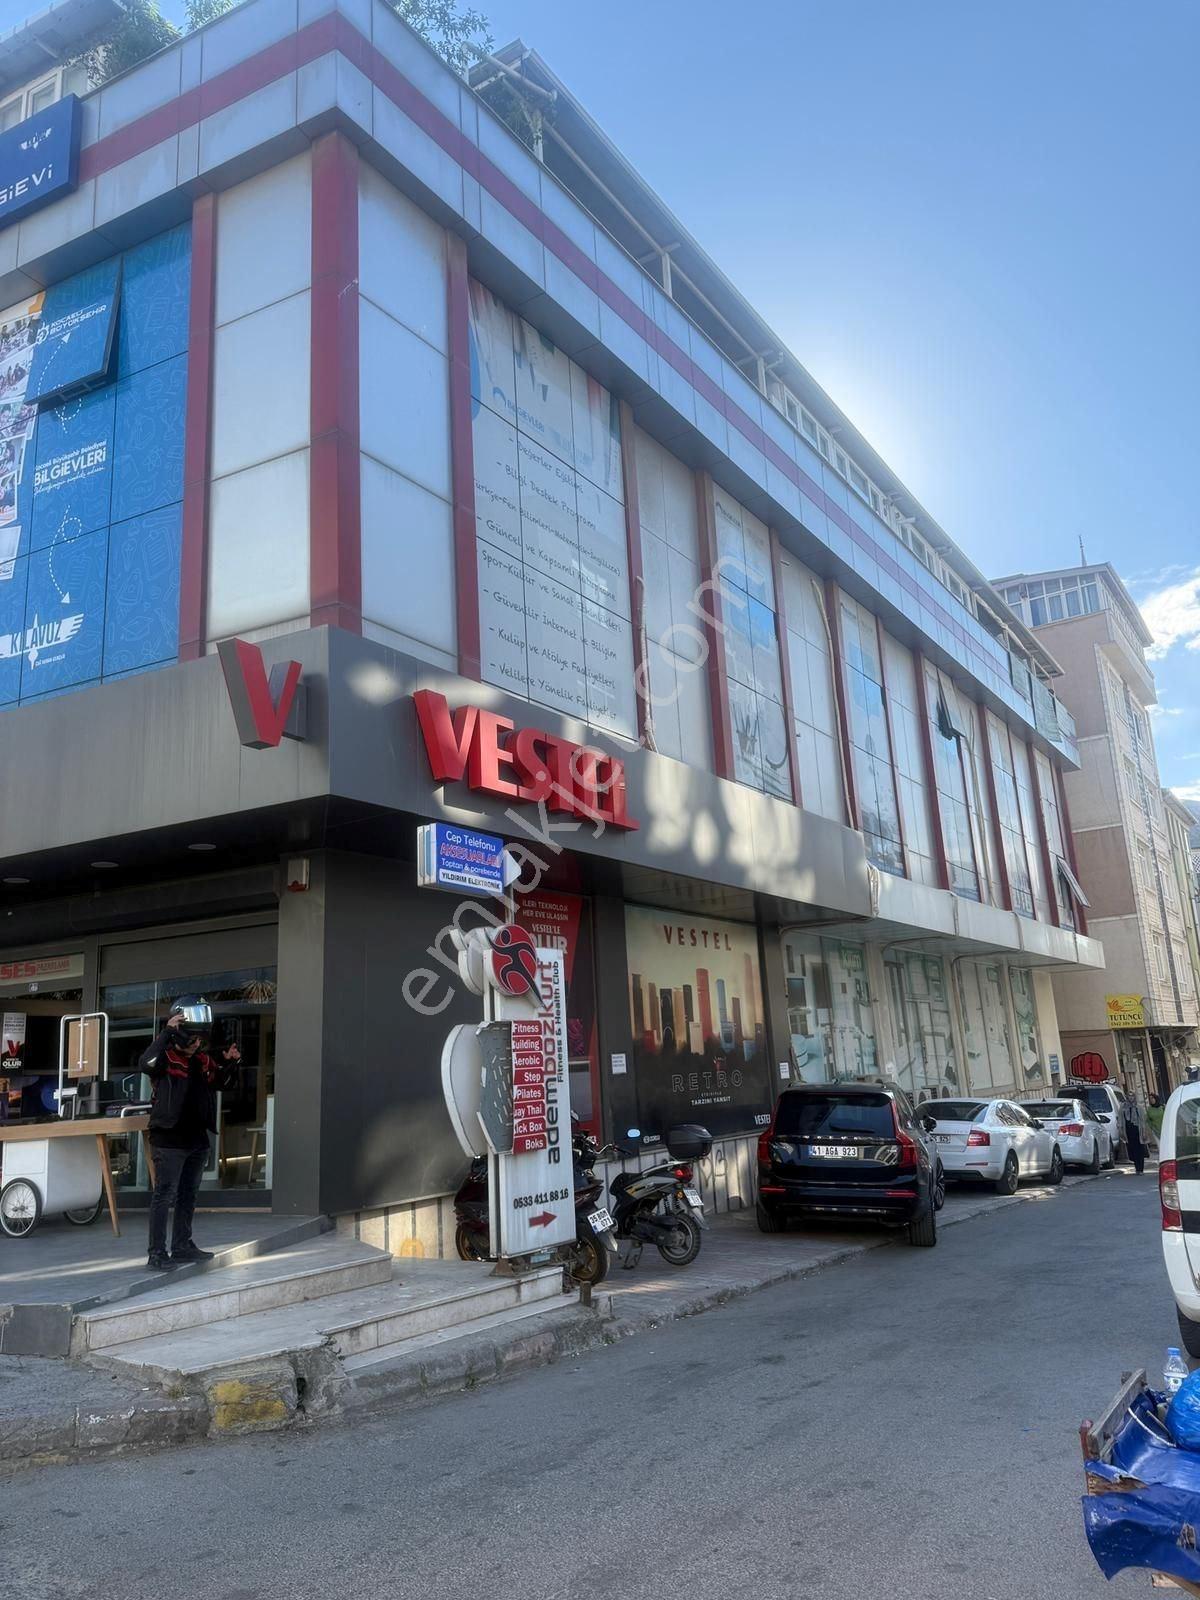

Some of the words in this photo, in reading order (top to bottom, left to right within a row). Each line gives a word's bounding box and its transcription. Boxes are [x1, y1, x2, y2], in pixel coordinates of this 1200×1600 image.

[413, 688, 639, 831] VESTEL
[446, 830, 462, 844] Cep
[464, 835, 496, 852] Telefonu
[441, 858, 464, 872] Toptan
[663, 925, 732, 951] VESTEL
[513, 1023, 539, 1033] Fitness
[556, 1040, 564, 1083] Fitness
[524, 1072, 541, 1082] Step
[671, 1069, 743, 1093] RETRO
[516, 1088, 541, 1099] Pilates
[529, 1122, 543, 1132] Box
[525, 1138, 544, 1149] Boks
[842, 1147, 857, 1155] 923
[513, 1195, 533, 1209] 0533
[534, 1192, 549, 1204] 411
[560, 1188, 569, 1200] 16
